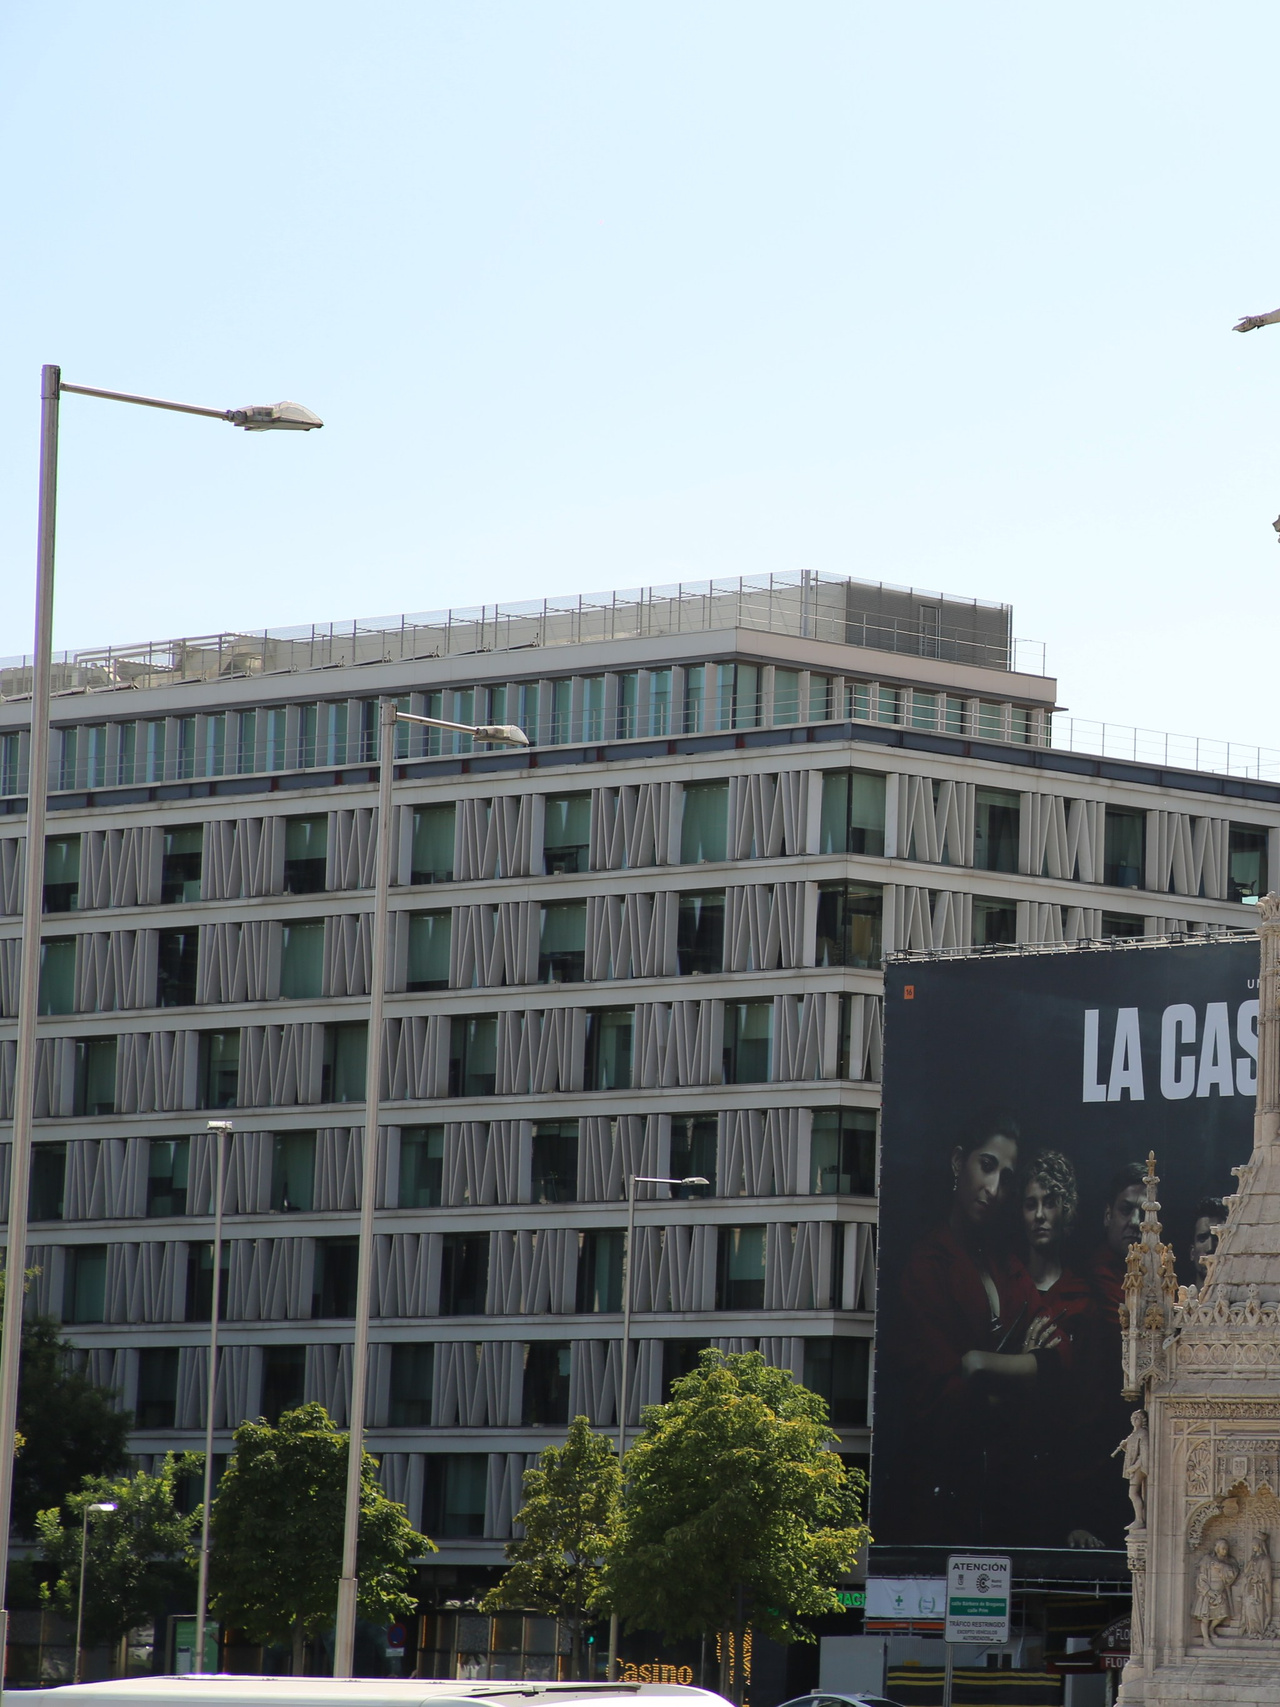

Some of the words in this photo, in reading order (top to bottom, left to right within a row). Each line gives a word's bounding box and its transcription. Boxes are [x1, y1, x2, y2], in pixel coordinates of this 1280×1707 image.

[1082, 1007, 1145, 1103] LA
[1160, 999, 1259, 1100] CAS
[952, 1562, 1007, 1572] ATENCIÓN
[949, 1620, 971, 1628] TRÁFICO
[1115, 1629, 1131, 1640] FLO
